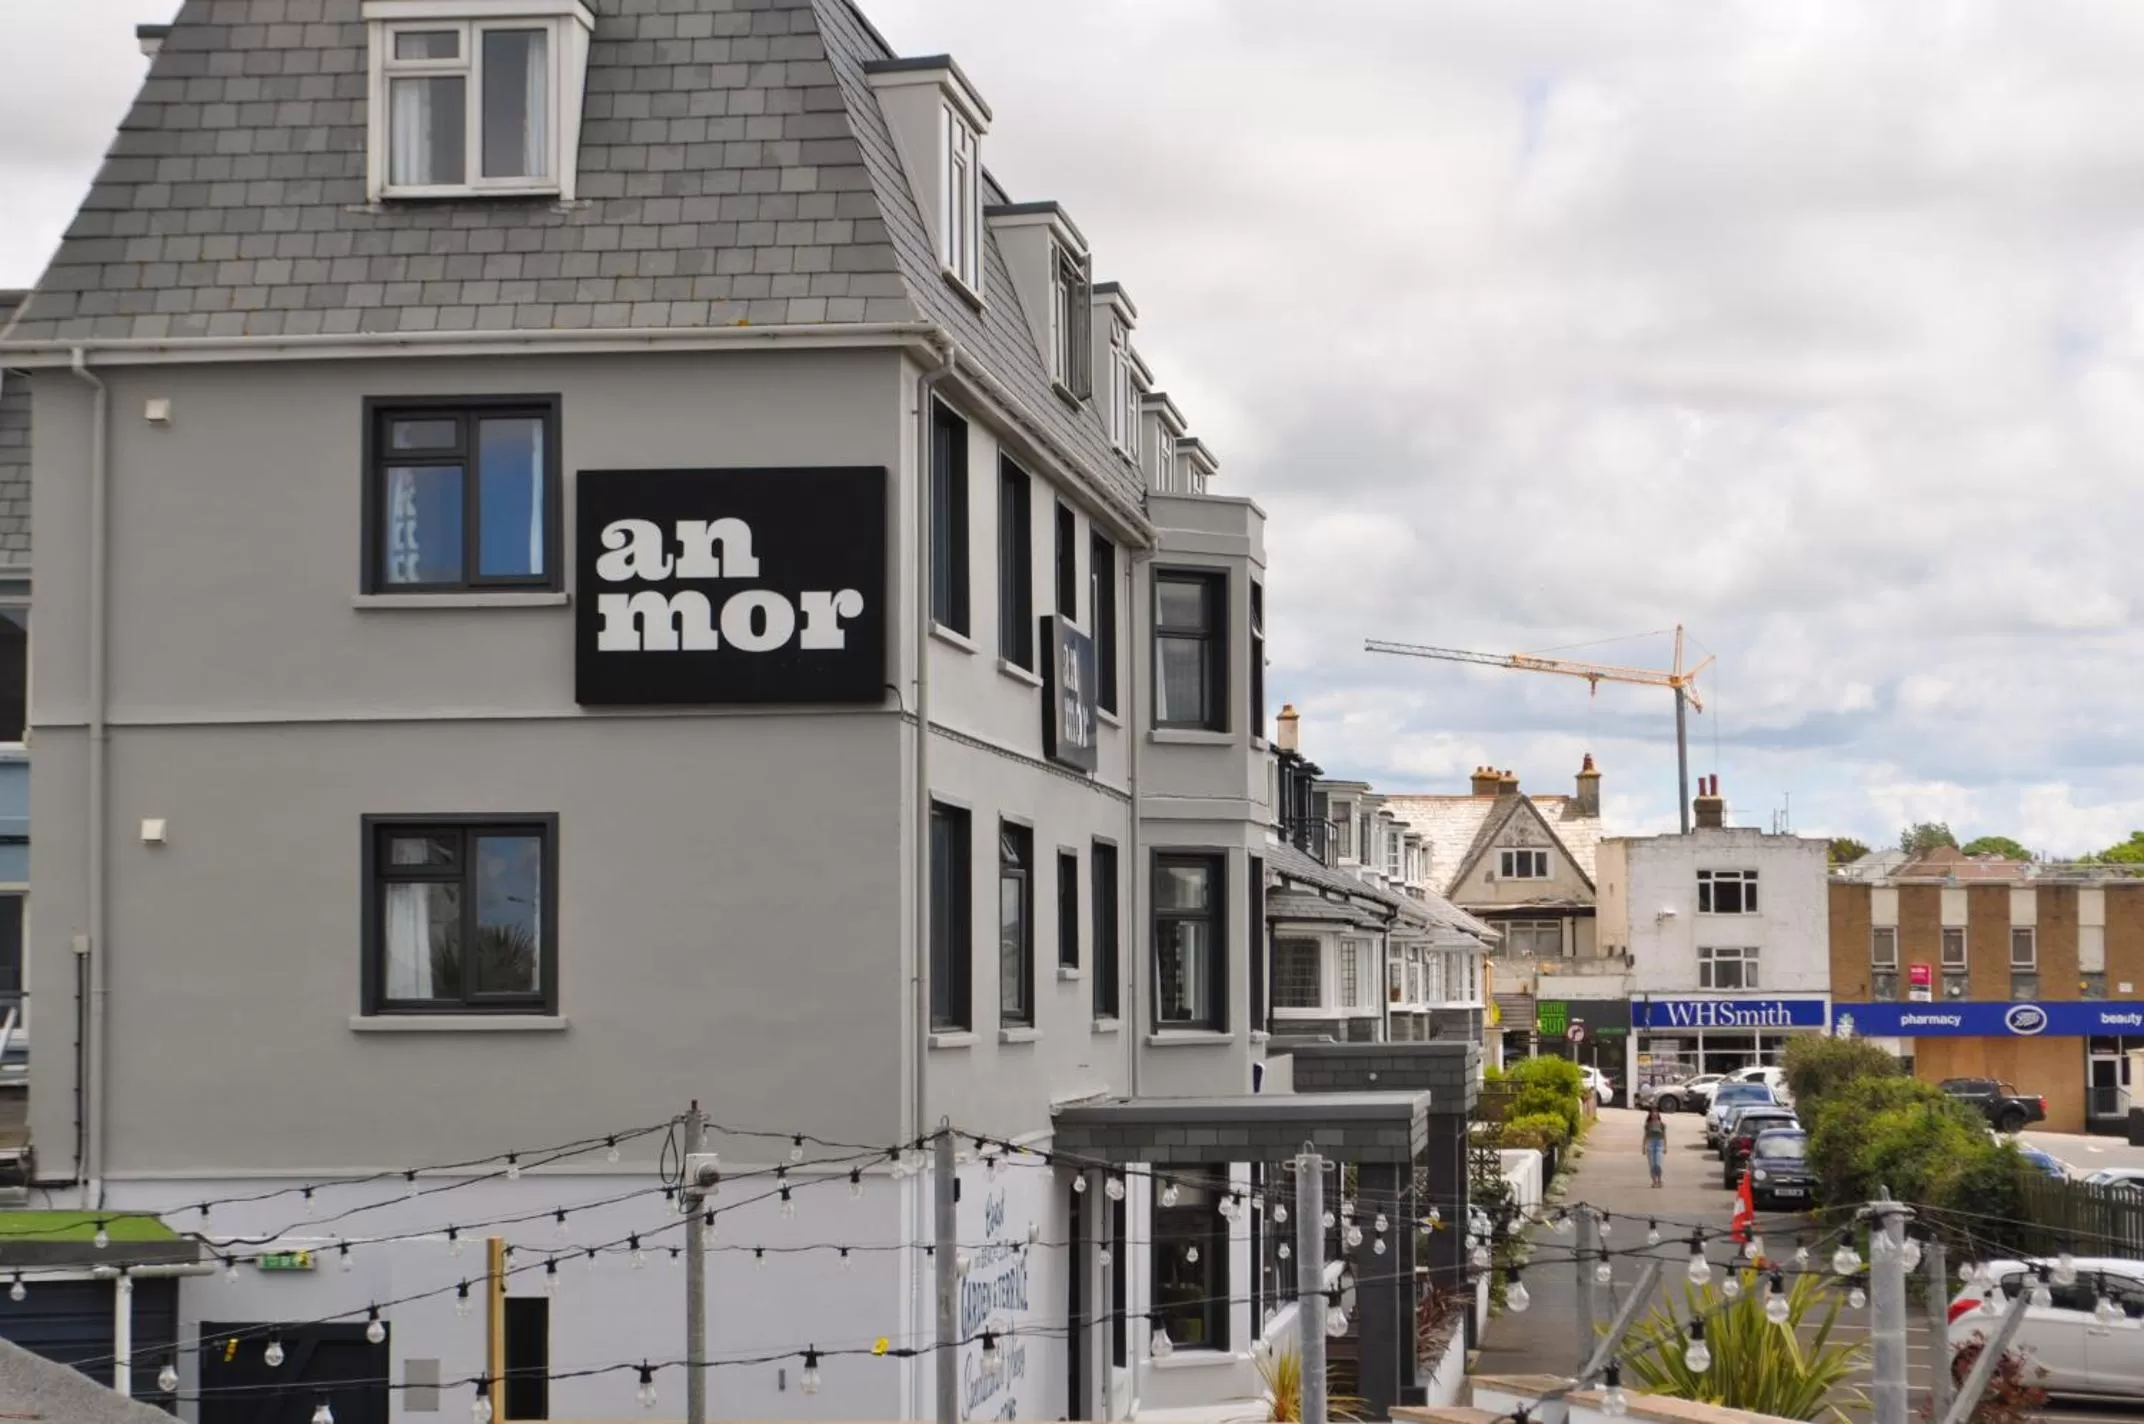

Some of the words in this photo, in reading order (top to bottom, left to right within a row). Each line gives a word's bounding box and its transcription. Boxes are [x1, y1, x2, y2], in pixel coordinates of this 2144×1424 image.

[596, 517, 759, 582] an
[597, 589, 864, 653] mor
[1665, 1002, 1792, 1026] WHSmith
[1900, 1013, 1962, 1027] pharmacy
[2100, 1012, 2143, 1026] beauty
[962, 1276, 991, 1340] GARDEN
